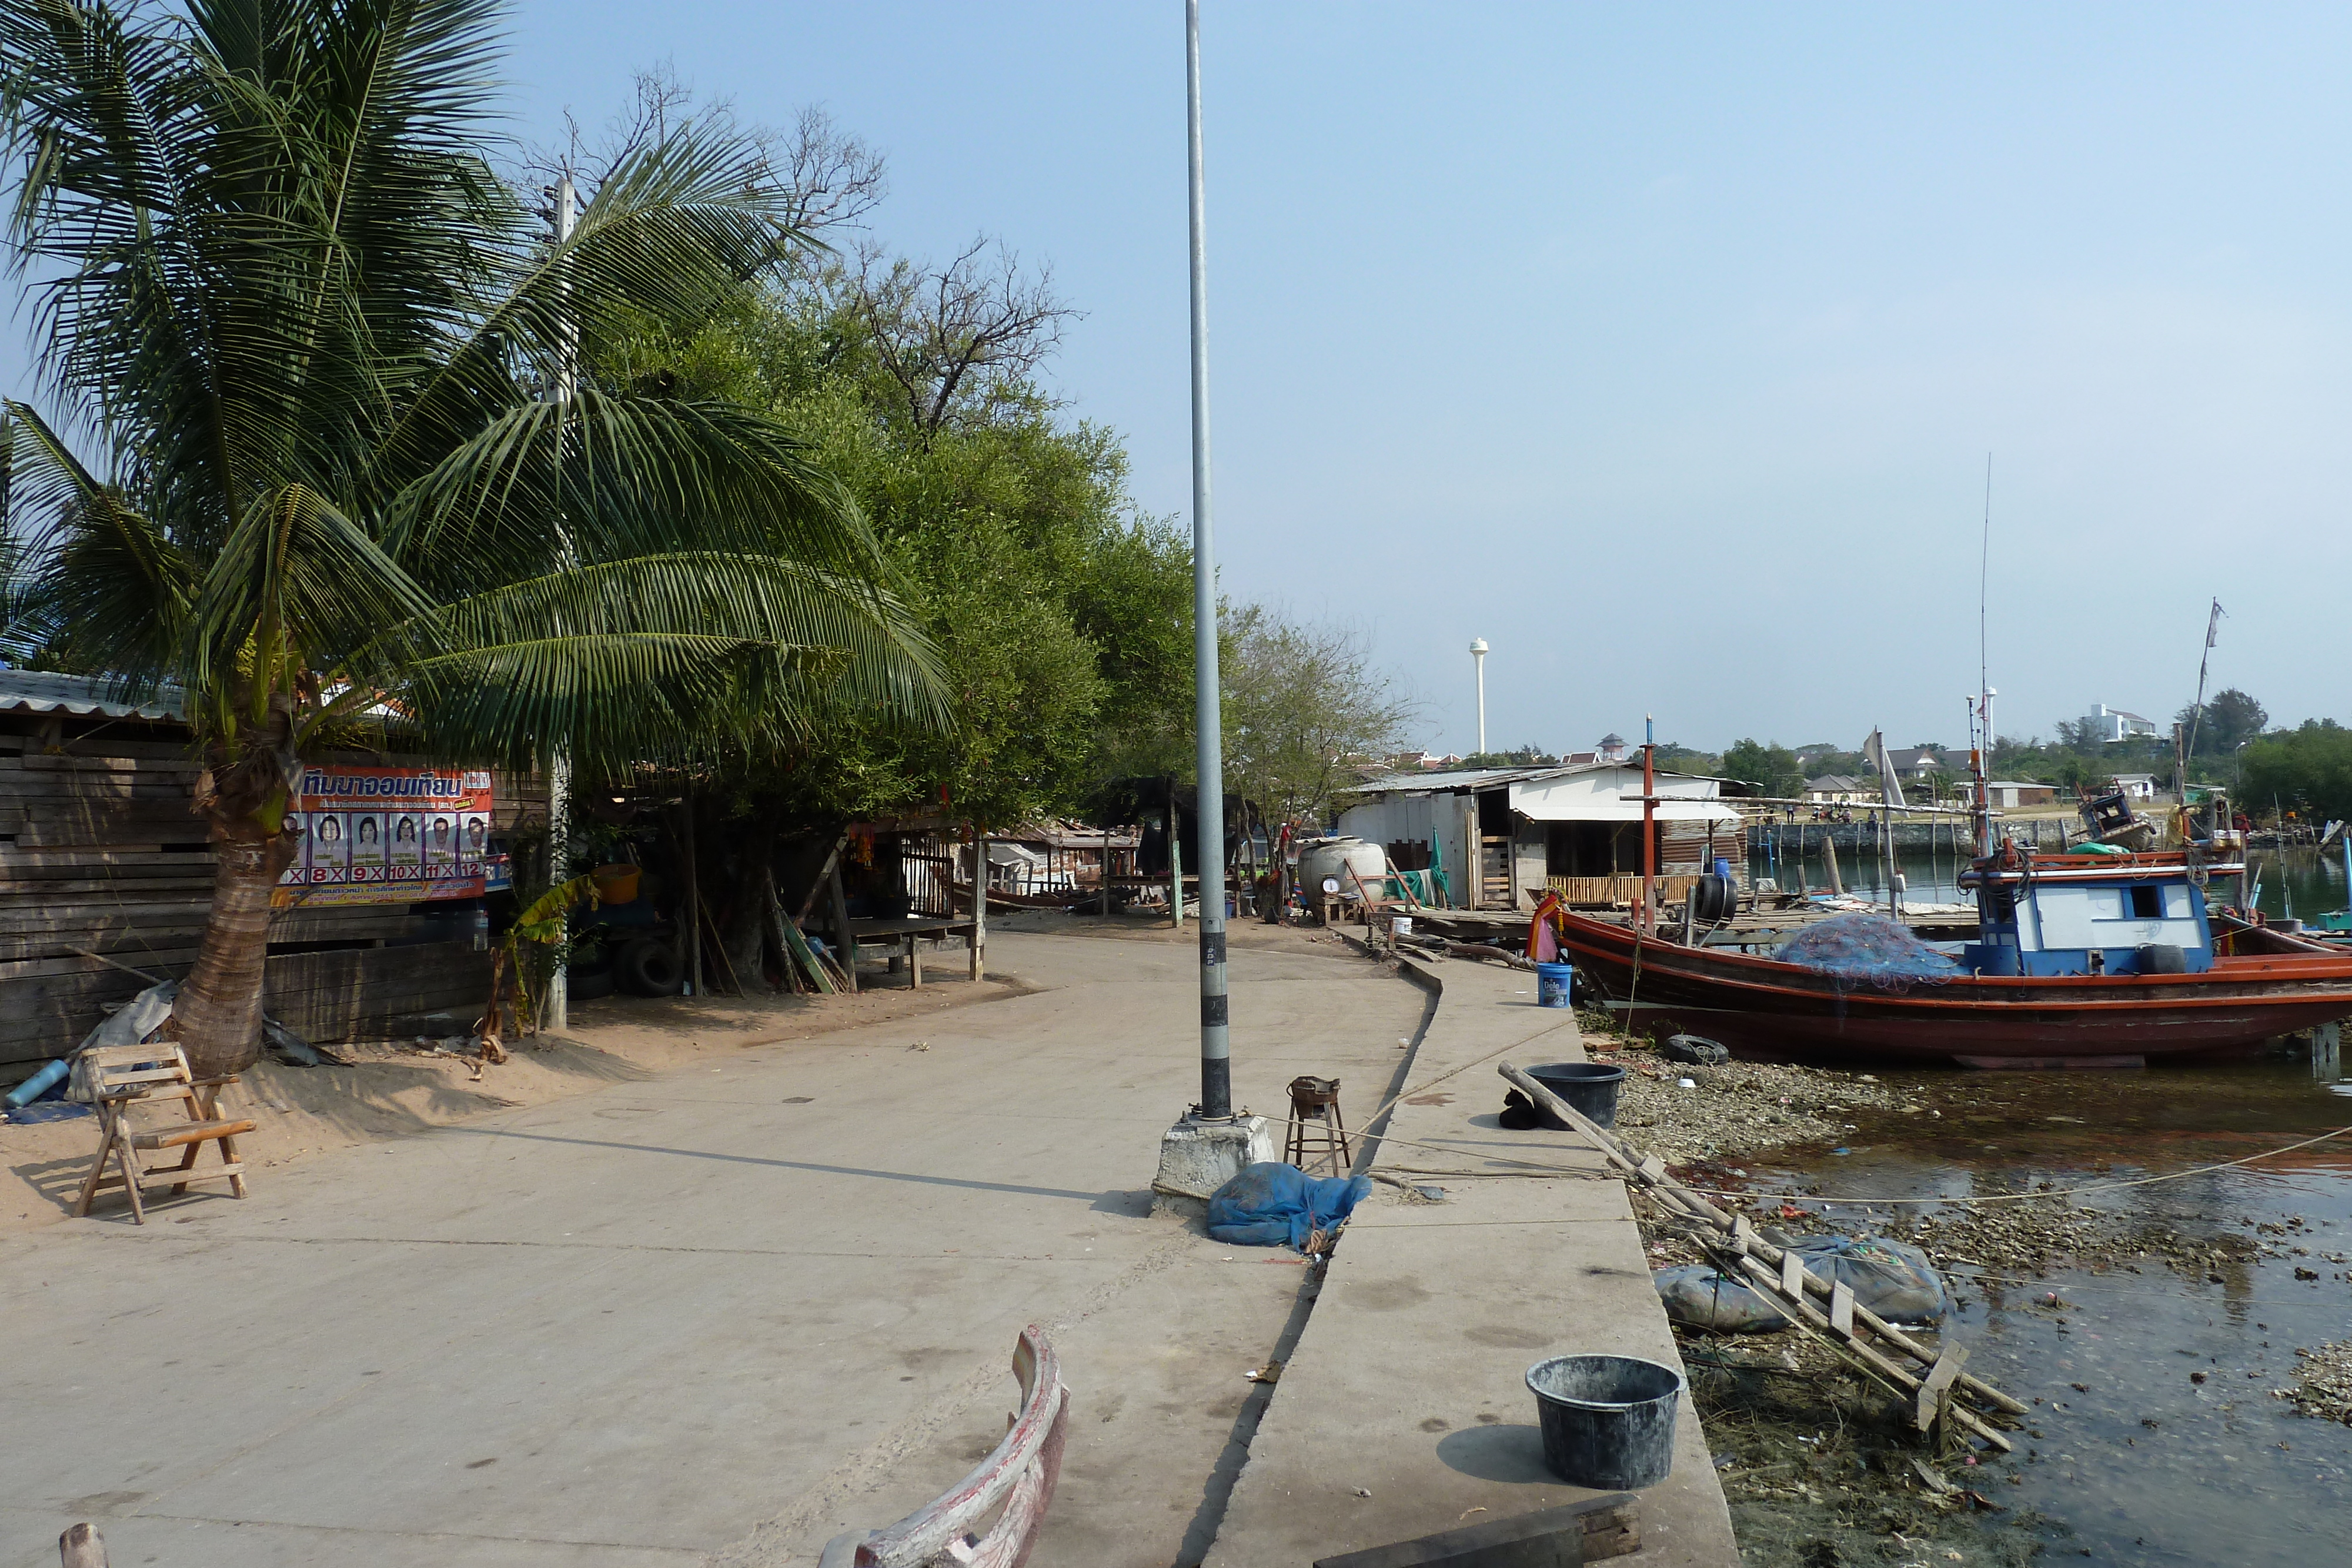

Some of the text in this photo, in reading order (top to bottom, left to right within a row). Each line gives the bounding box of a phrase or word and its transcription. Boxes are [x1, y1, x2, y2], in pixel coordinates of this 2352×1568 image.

[302, 768, 463, 798] ทีมนาจอมเทียน
[313, 868, 326, 881] 8
[354, 867, 366, 880] 9
[391, 866, 405, 878] 10
[427, 865, 439, 877] 11
[462, 863, 479, 875] 12
[1544, 981, 1560, 989] Delo
